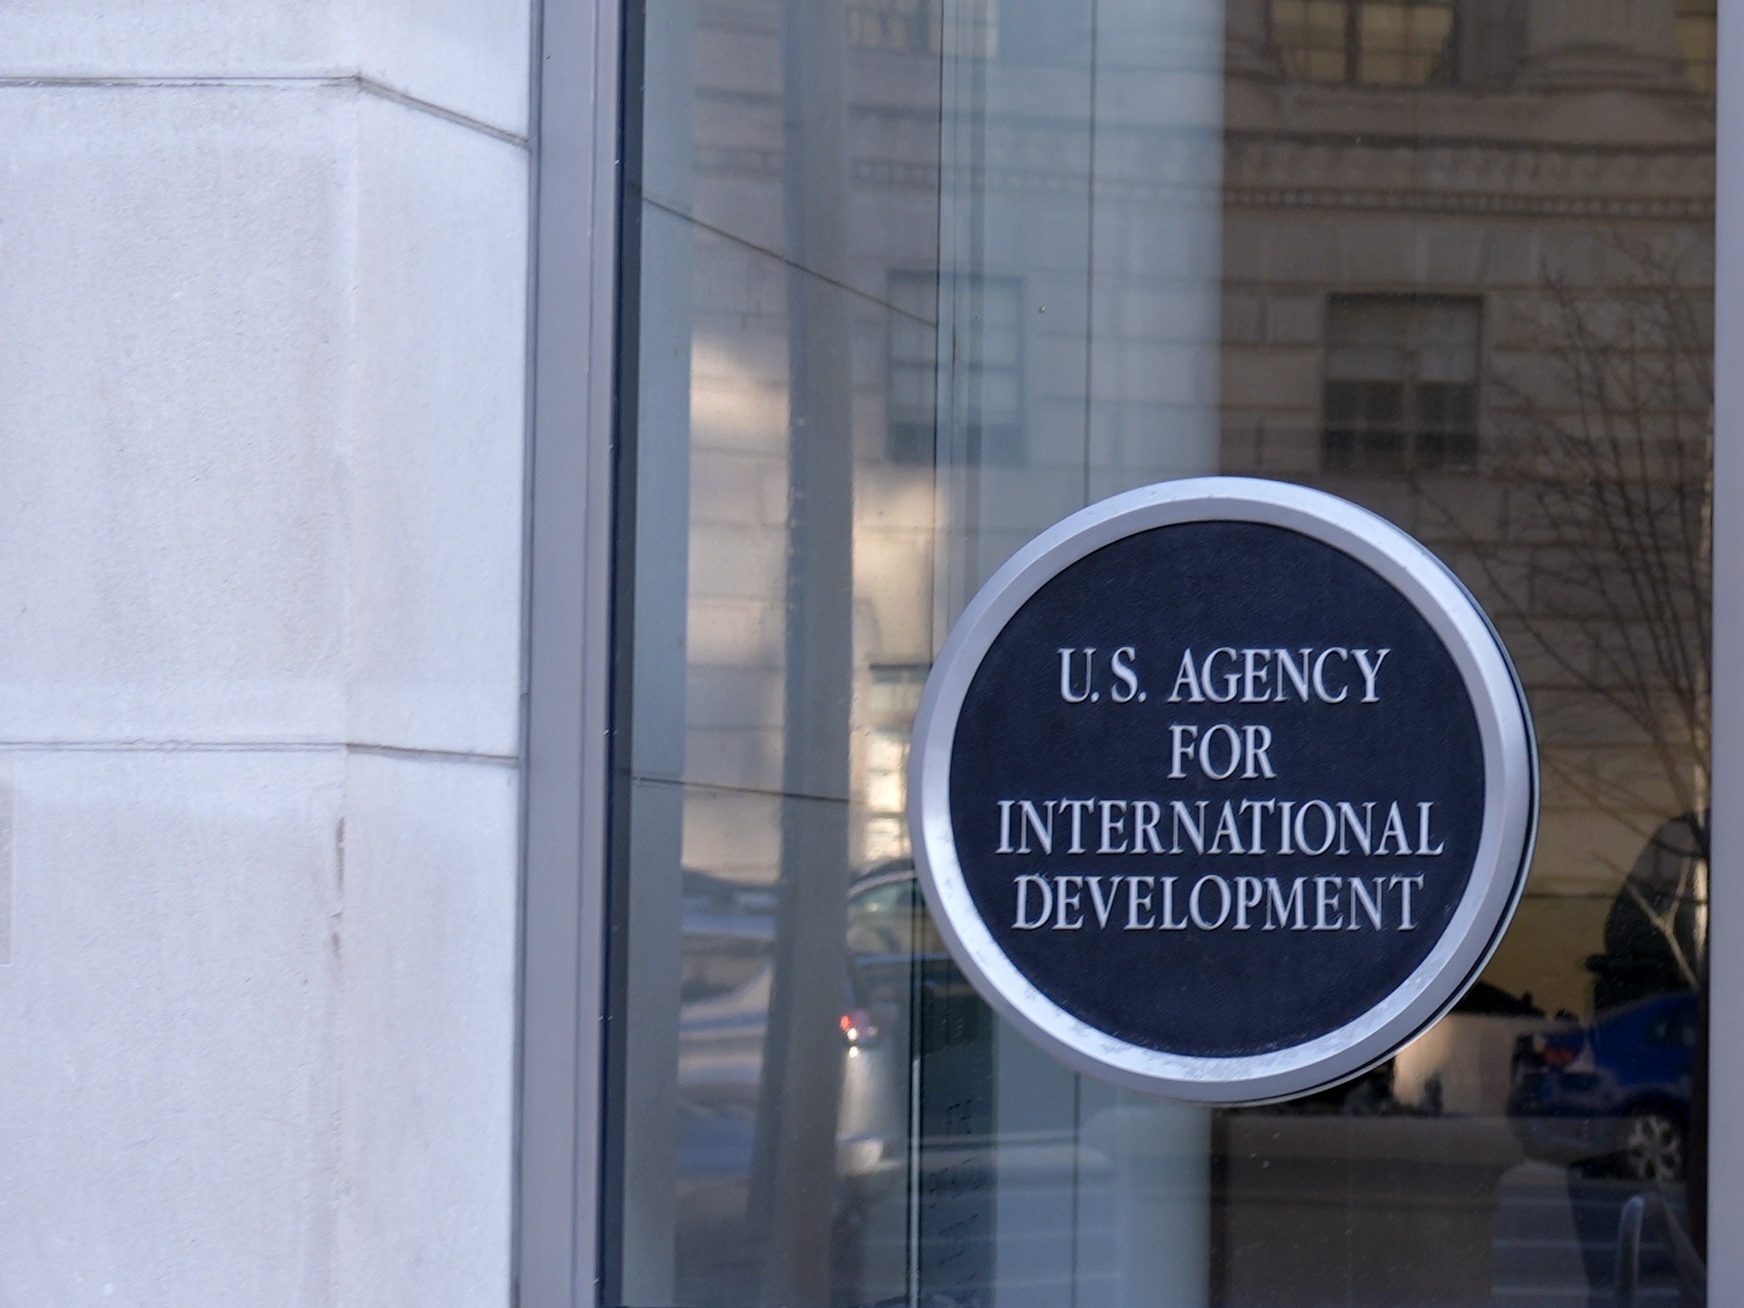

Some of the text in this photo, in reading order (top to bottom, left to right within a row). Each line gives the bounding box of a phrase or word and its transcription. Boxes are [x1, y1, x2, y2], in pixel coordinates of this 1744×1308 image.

[1058, 646, 1391, 703] U.S. AGENCY
[1167, 723, 1276, 780] FOR
[996, 797, 1445, 857] INTERNATIONAL
[1011, 873, 1424, 931] DEVELOPMENT
